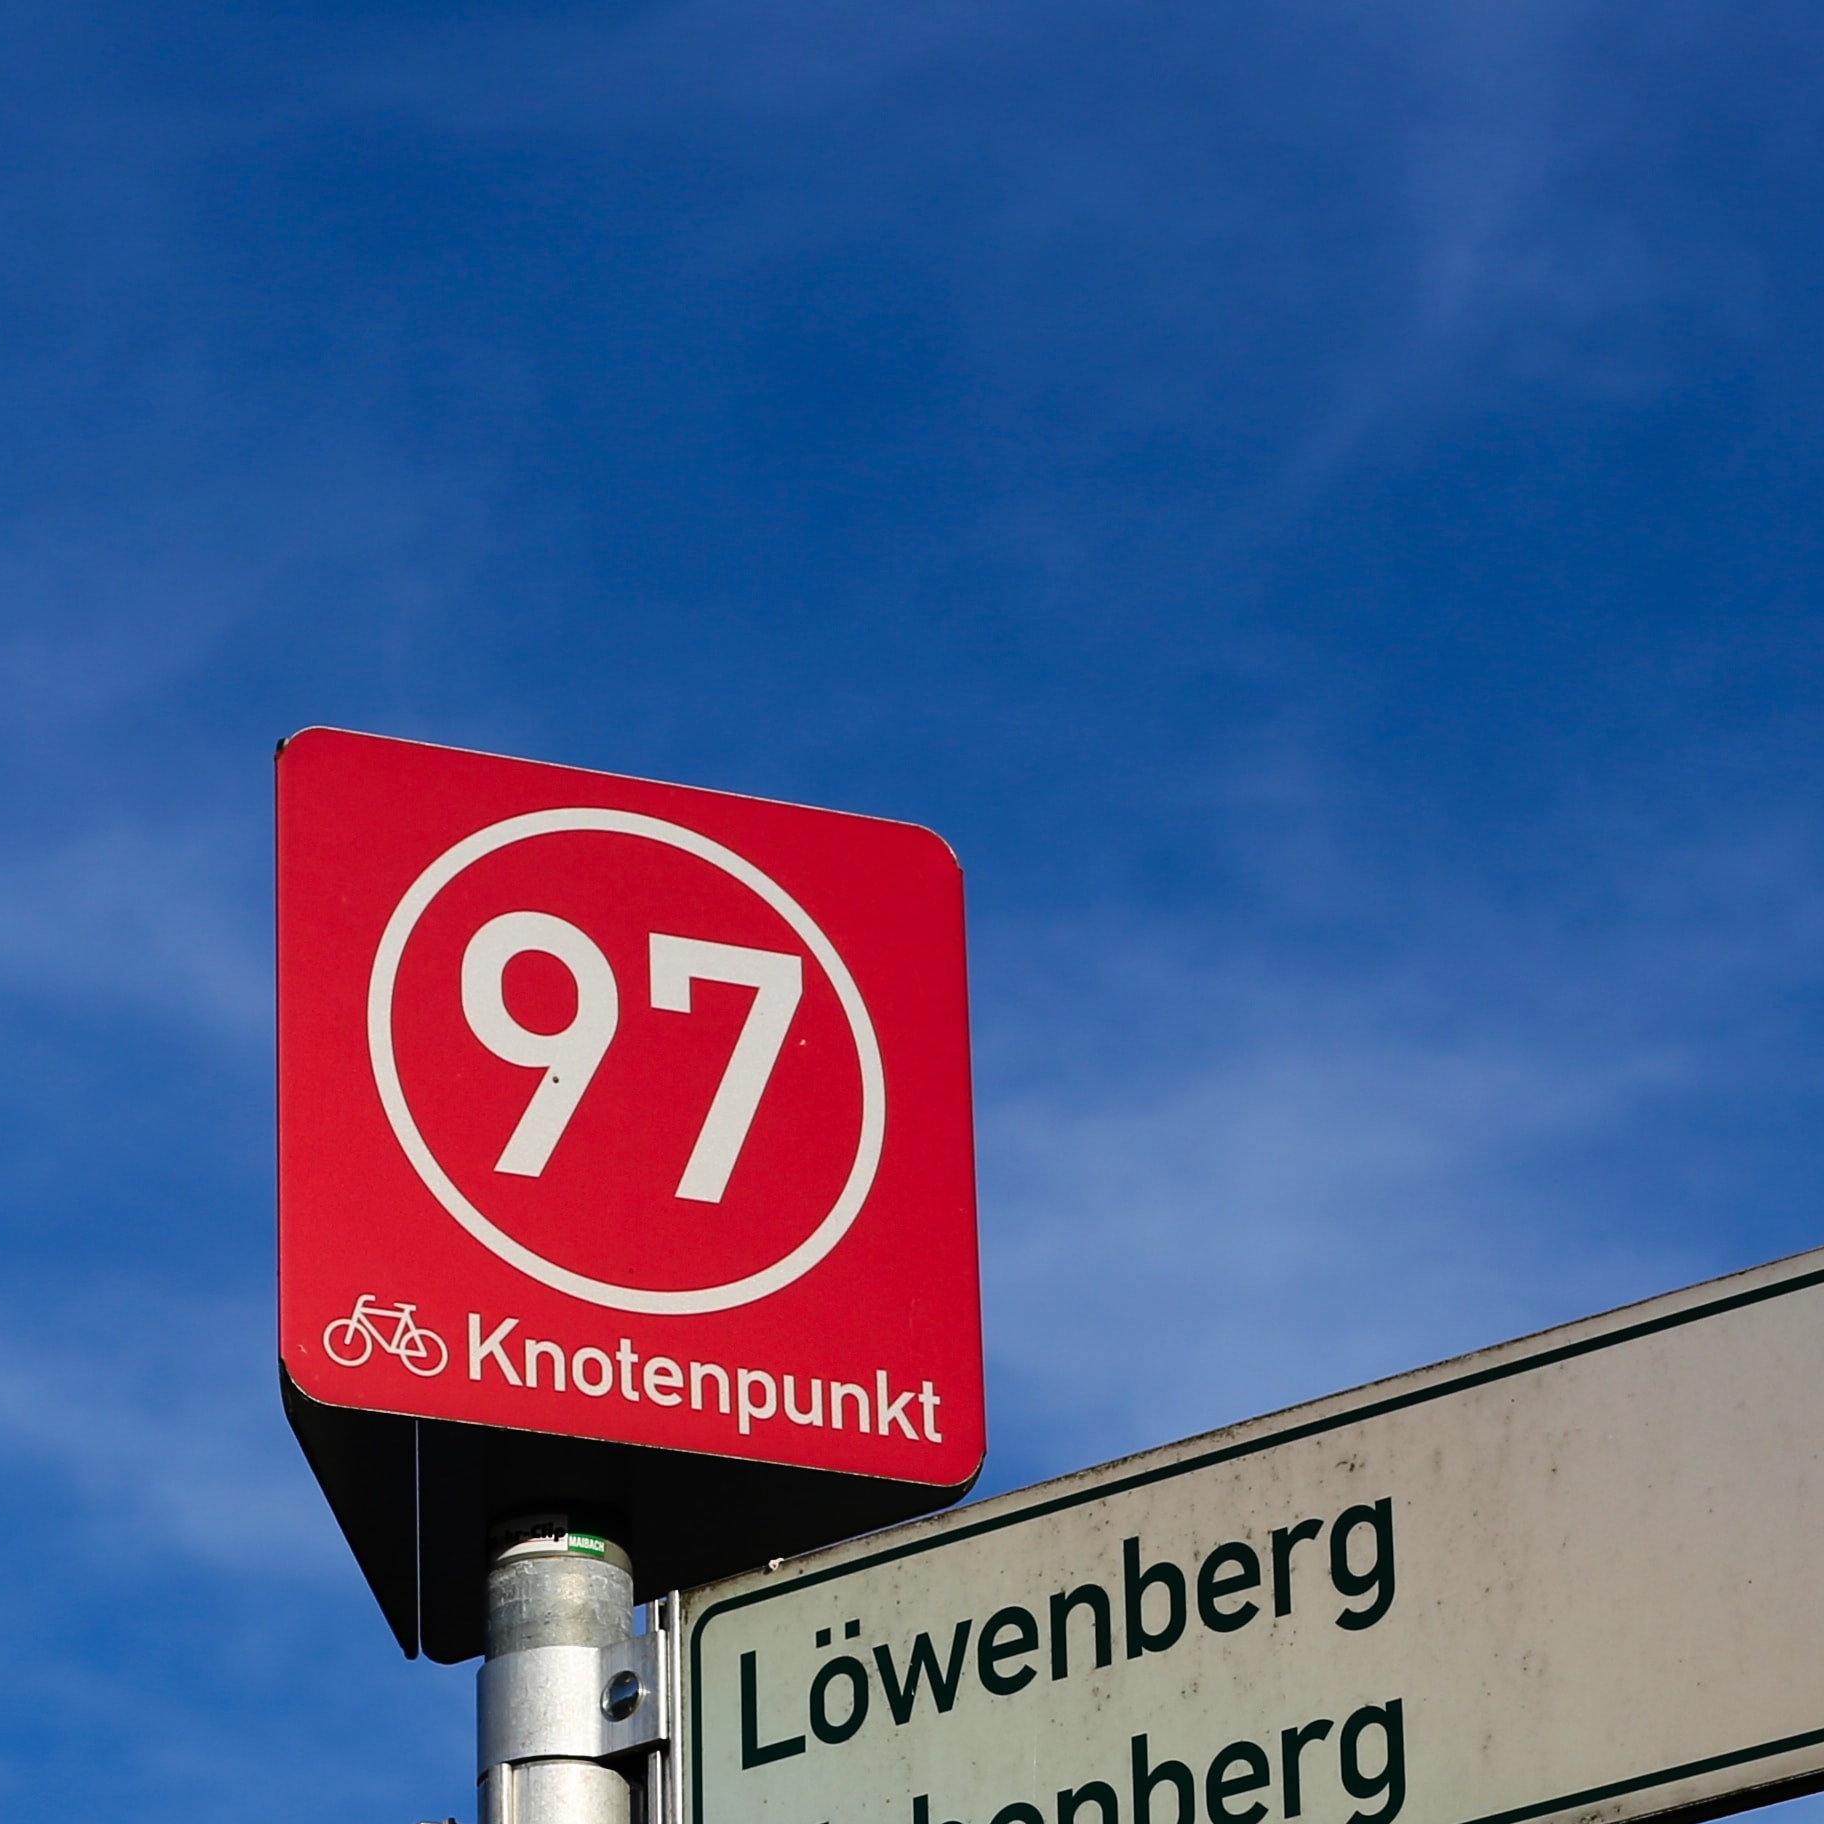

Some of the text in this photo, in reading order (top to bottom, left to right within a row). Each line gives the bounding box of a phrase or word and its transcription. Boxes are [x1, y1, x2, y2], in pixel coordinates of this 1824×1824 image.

[461, 911, 802, 1204] 97
[467, 1312, 943, 1444] Knotenpunkt
[569, 1535, 605, 1552] MAIBACH
[739, 1496, 1395, 1769] Löwenberg
